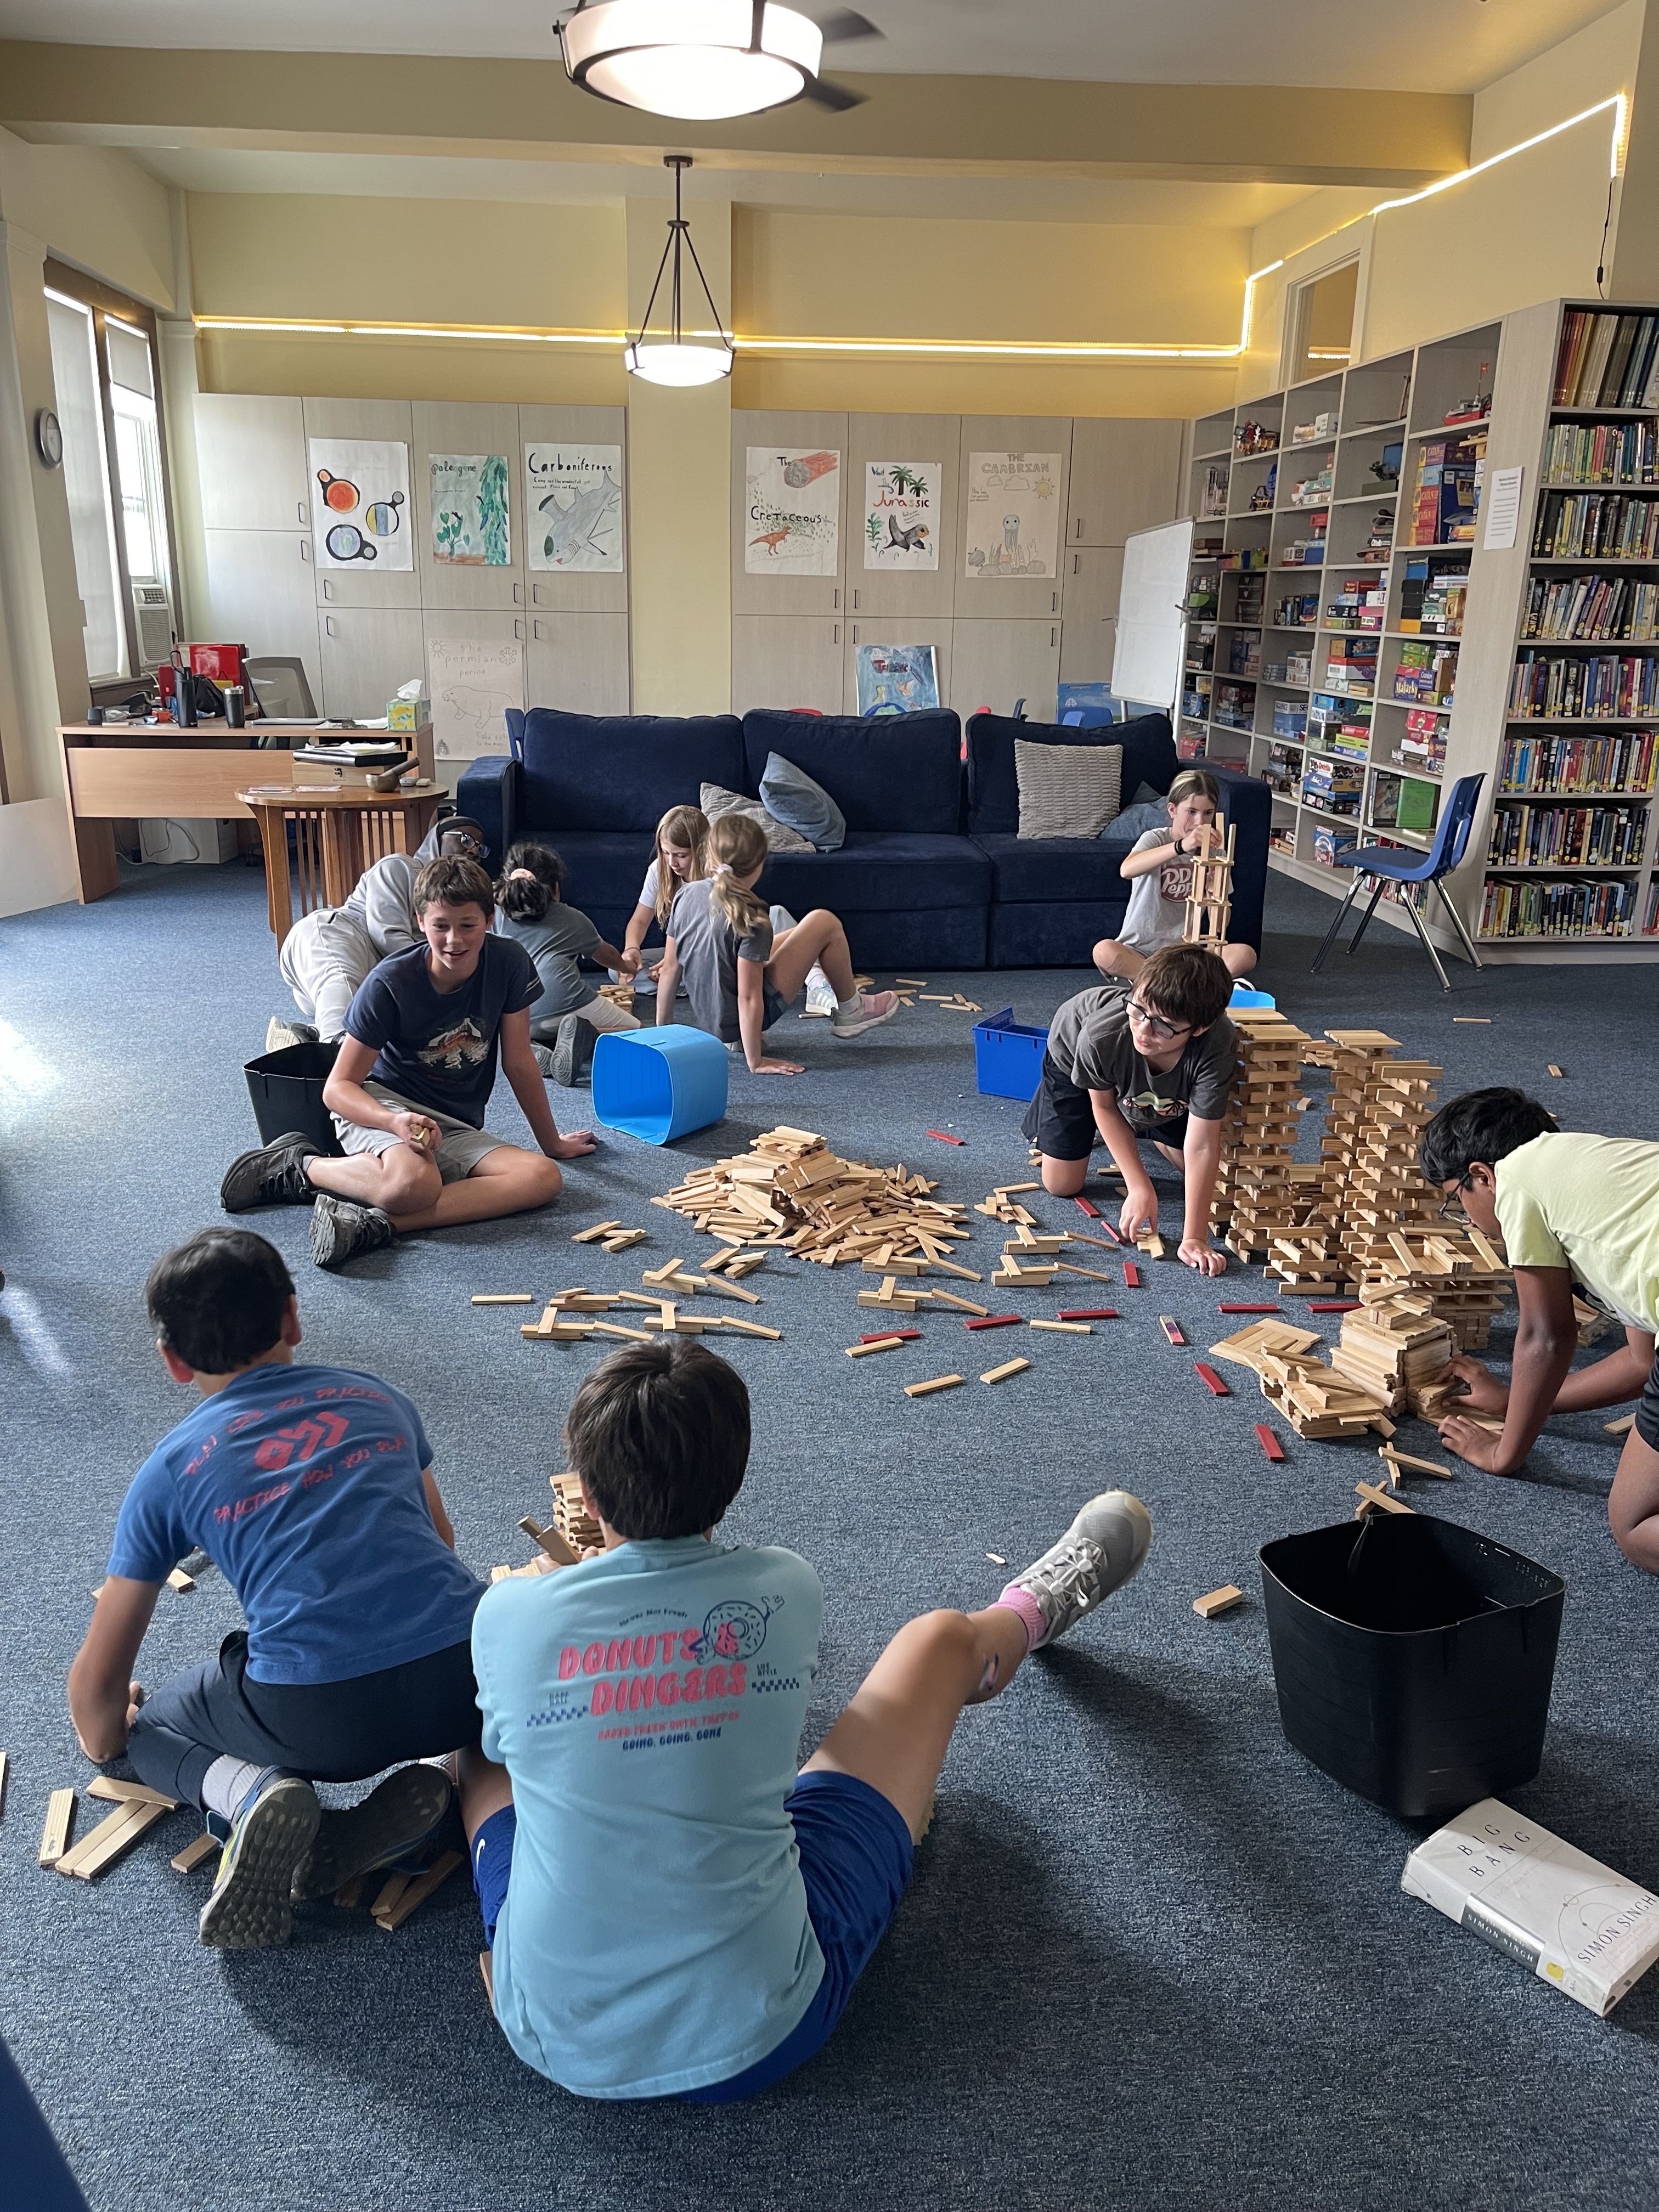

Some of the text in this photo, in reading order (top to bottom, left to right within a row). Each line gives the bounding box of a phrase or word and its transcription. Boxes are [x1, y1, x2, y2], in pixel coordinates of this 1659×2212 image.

[528, 453, 612, 473] Carboniferous
[776, 456, 792, 466] The
[981, 462, 1049, 474] CAMBRIAN
[1007, 454, 1025, 462] THE
[873, 490, 929, 507] Jurassic
[461, 643, 481, 652] the
[445, 655, 496, 668] permian
[460, 669, 485, 679] period
[1396, 680, 1418, 697] Malarky
[1161, 868, 1192, 898] Pepp
[1512, 885, 1521, 910] WOOL
[213, 1482, 291, 1525] PRACTICE
[341, 1449, 370, 1469] YOU
[558, 1628, 702, 1680] DONUTS
[591, 1662, 748, 1717] DINGERS
[1457, 1824, 1500, 1855] BIG
[1469, 1831, 1530, 1877] BANG
[1468, 1914, 1499, 1939] SIMON
[1503, 1938, 1533, 1962] SINGH
[1577, 1926, 1621, 1964] SIMON
[1617, 1895, 1657, 1928] SINGH
